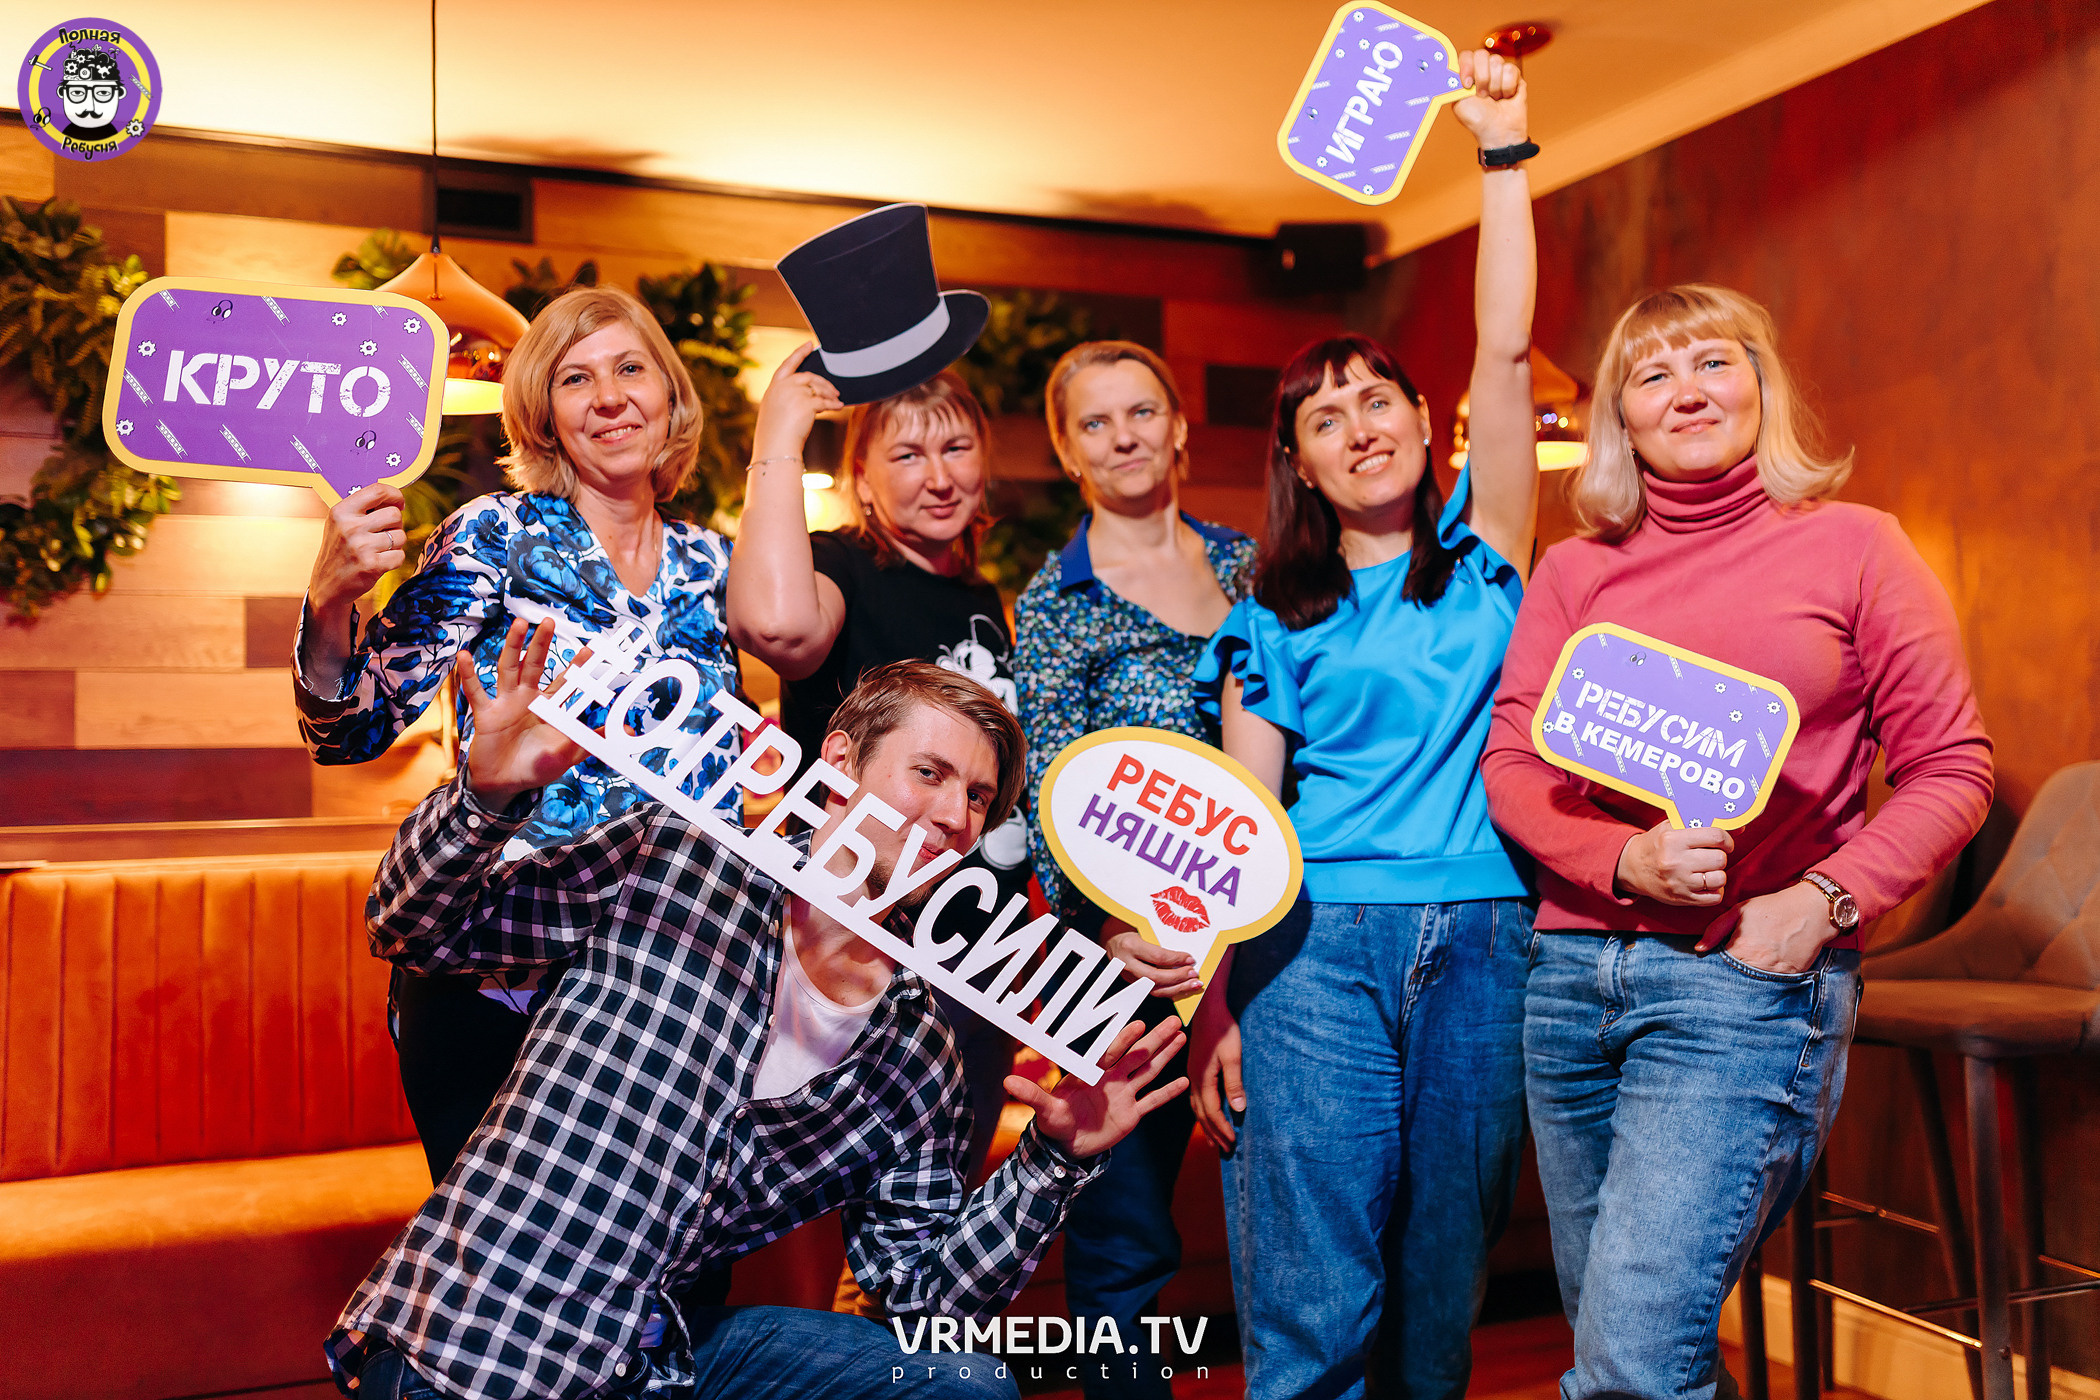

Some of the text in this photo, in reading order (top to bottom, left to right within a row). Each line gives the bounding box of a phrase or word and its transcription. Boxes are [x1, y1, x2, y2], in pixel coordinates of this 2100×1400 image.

[1325, 41, 1403, 164] ИГРАЮ
[163, 350, 391, 418] КРУТО
[1554, 710, 1746, 800] В КЕМЕРОВО
[1575, 680, 1747, 768] РЕБУСИМ
[548, 619, 1156, 1068] #ОТРЕБУСИЛИ
[1078, 793, 1242, 907] НЯШКА
[1106, 754, 1258, 856] РЕБУС
